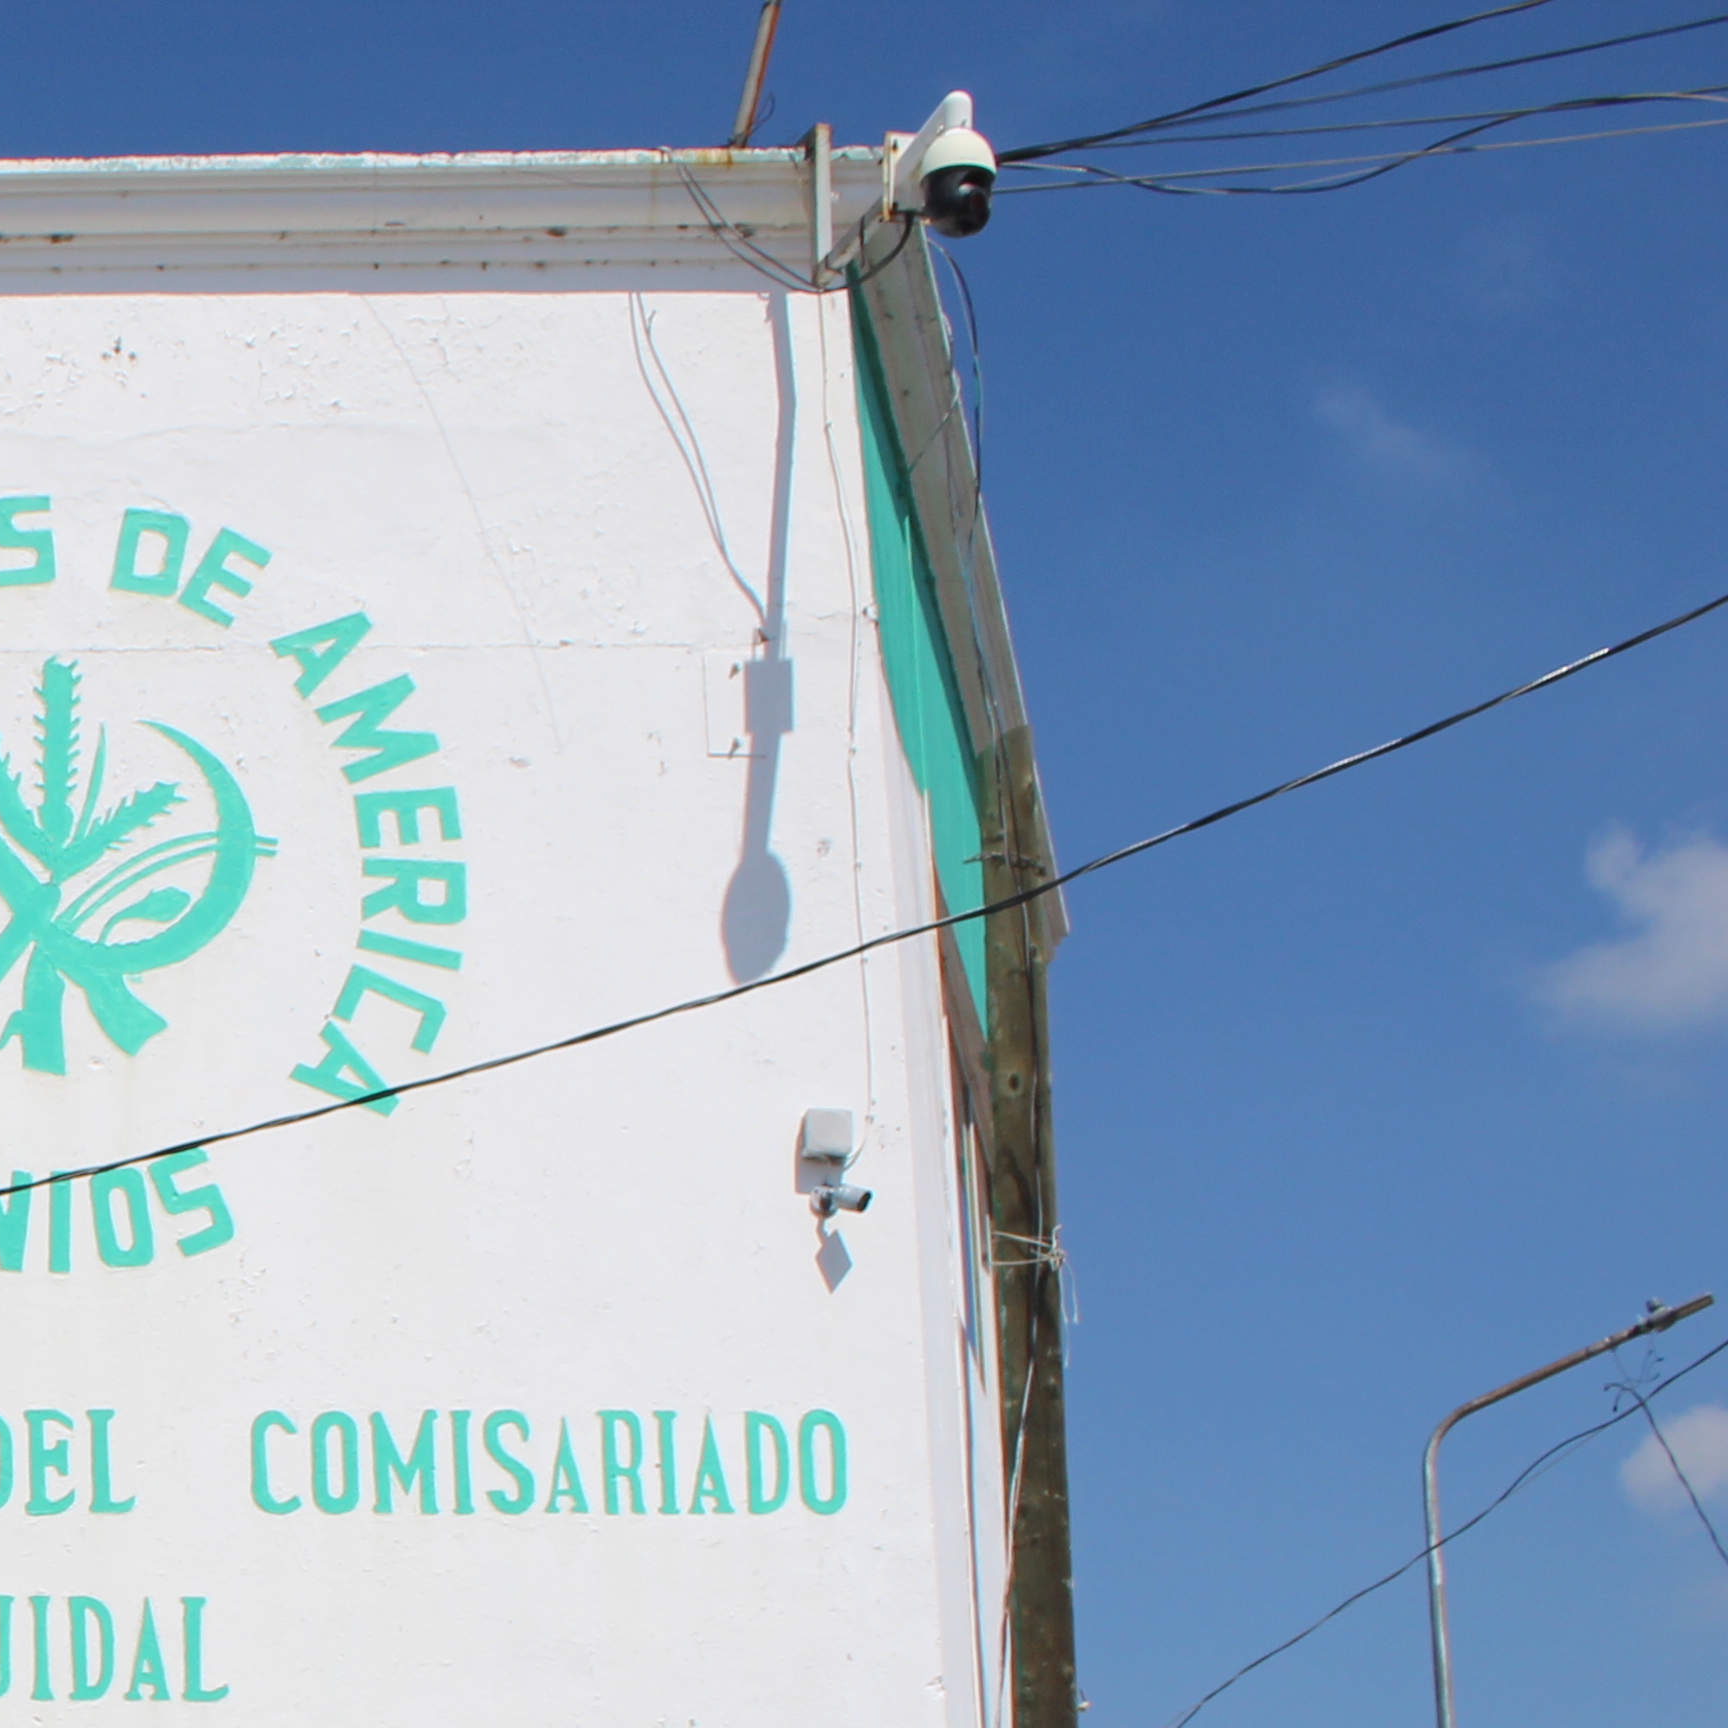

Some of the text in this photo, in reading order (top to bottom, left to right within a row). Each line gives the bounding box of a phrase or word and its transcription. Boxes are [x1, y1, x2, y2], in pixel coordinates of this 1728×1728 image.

[110, 506, 273, 628] DE
[269, 610, 468, 1118] AMERICA
[250, 1408, 849, 1516] COMISARIADO
